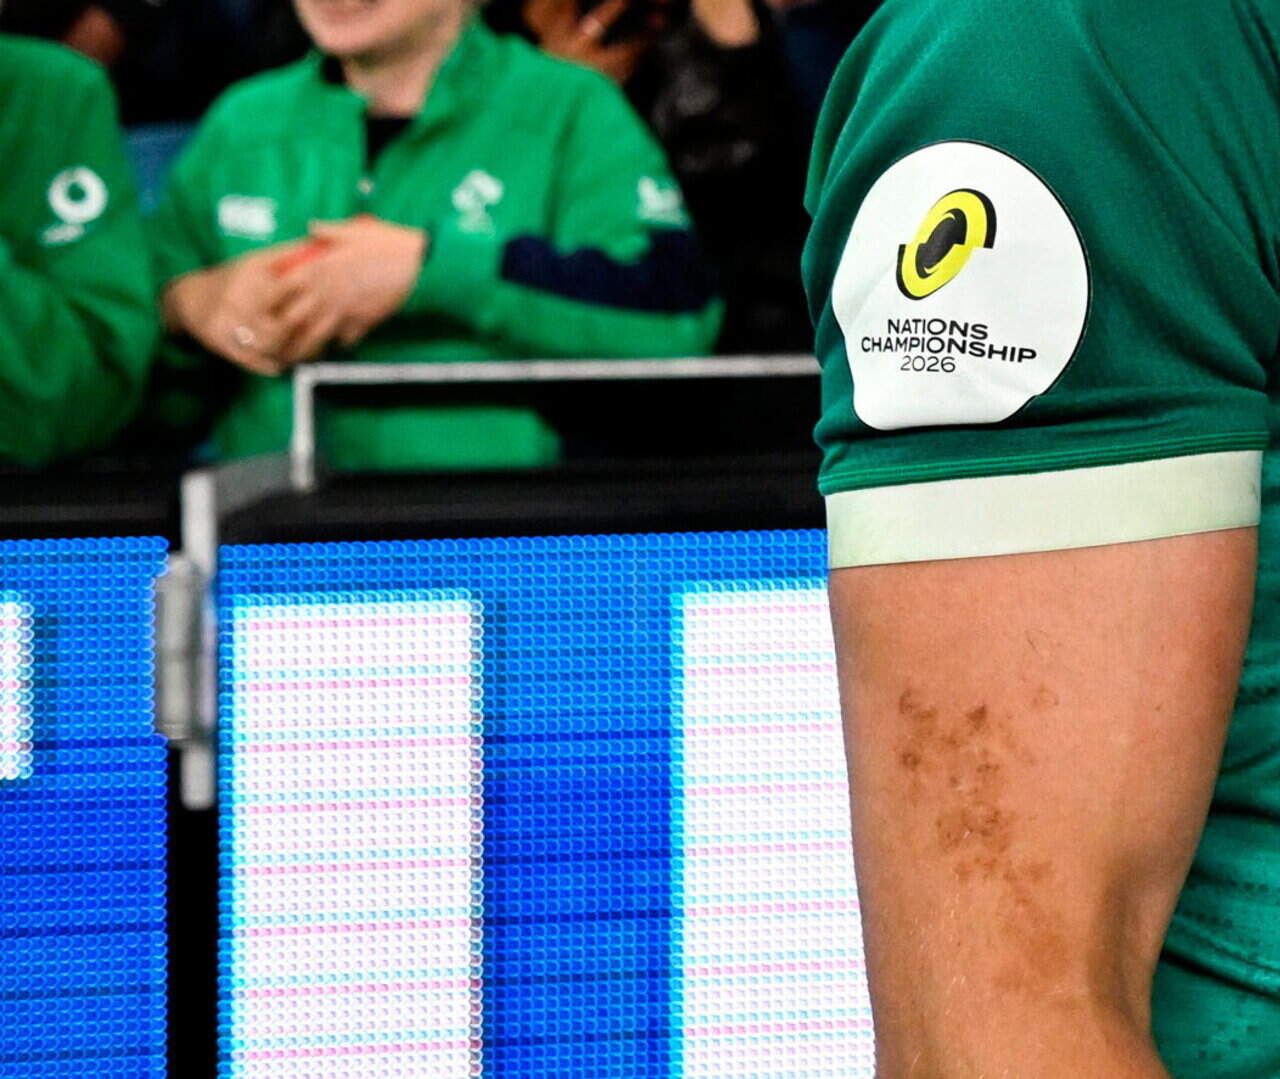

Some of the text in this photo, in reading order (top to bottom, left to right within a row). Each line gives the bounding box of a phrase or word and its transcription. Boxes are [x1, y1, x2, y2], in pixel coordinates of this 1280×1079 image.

[887, 318, 989, 340] NATIONS
[861, 336, 1037, 363] CHAMPIONSHIP
[900, 355, 957, 373] 2026
